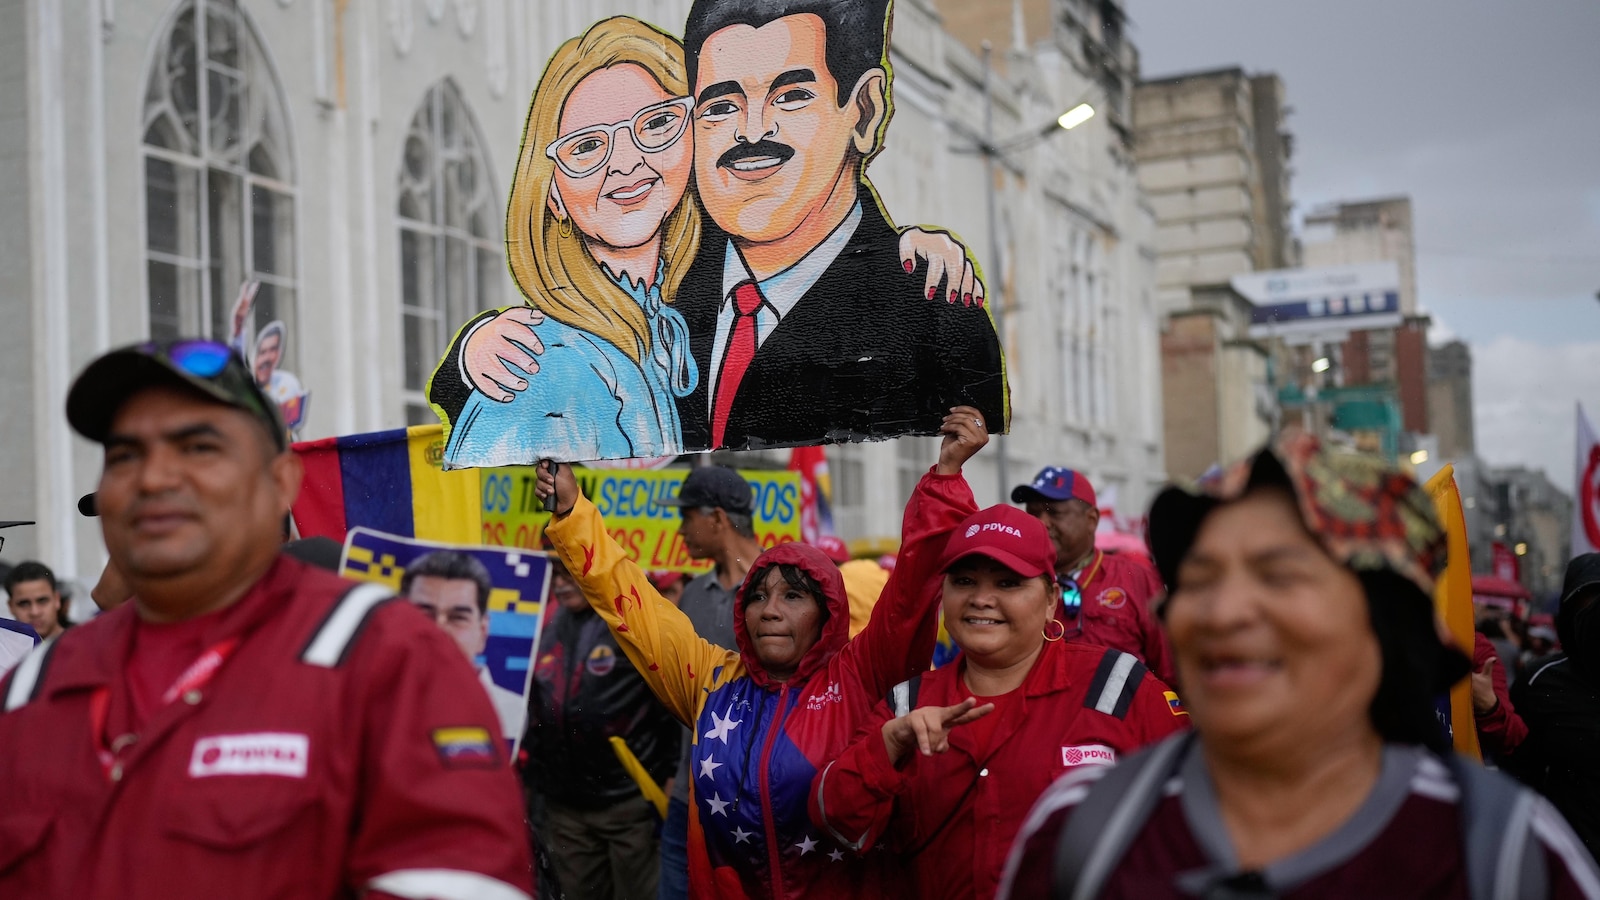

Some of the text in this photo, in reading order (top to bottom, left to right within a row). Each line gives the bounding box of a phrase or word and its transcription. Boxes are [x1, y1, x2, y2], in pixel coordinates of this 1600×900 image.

[483, 473, 512, 514] OS
[982, 522, 1022, 538] PDVSA
[1084, 750, 1113, 761] PDVSA
